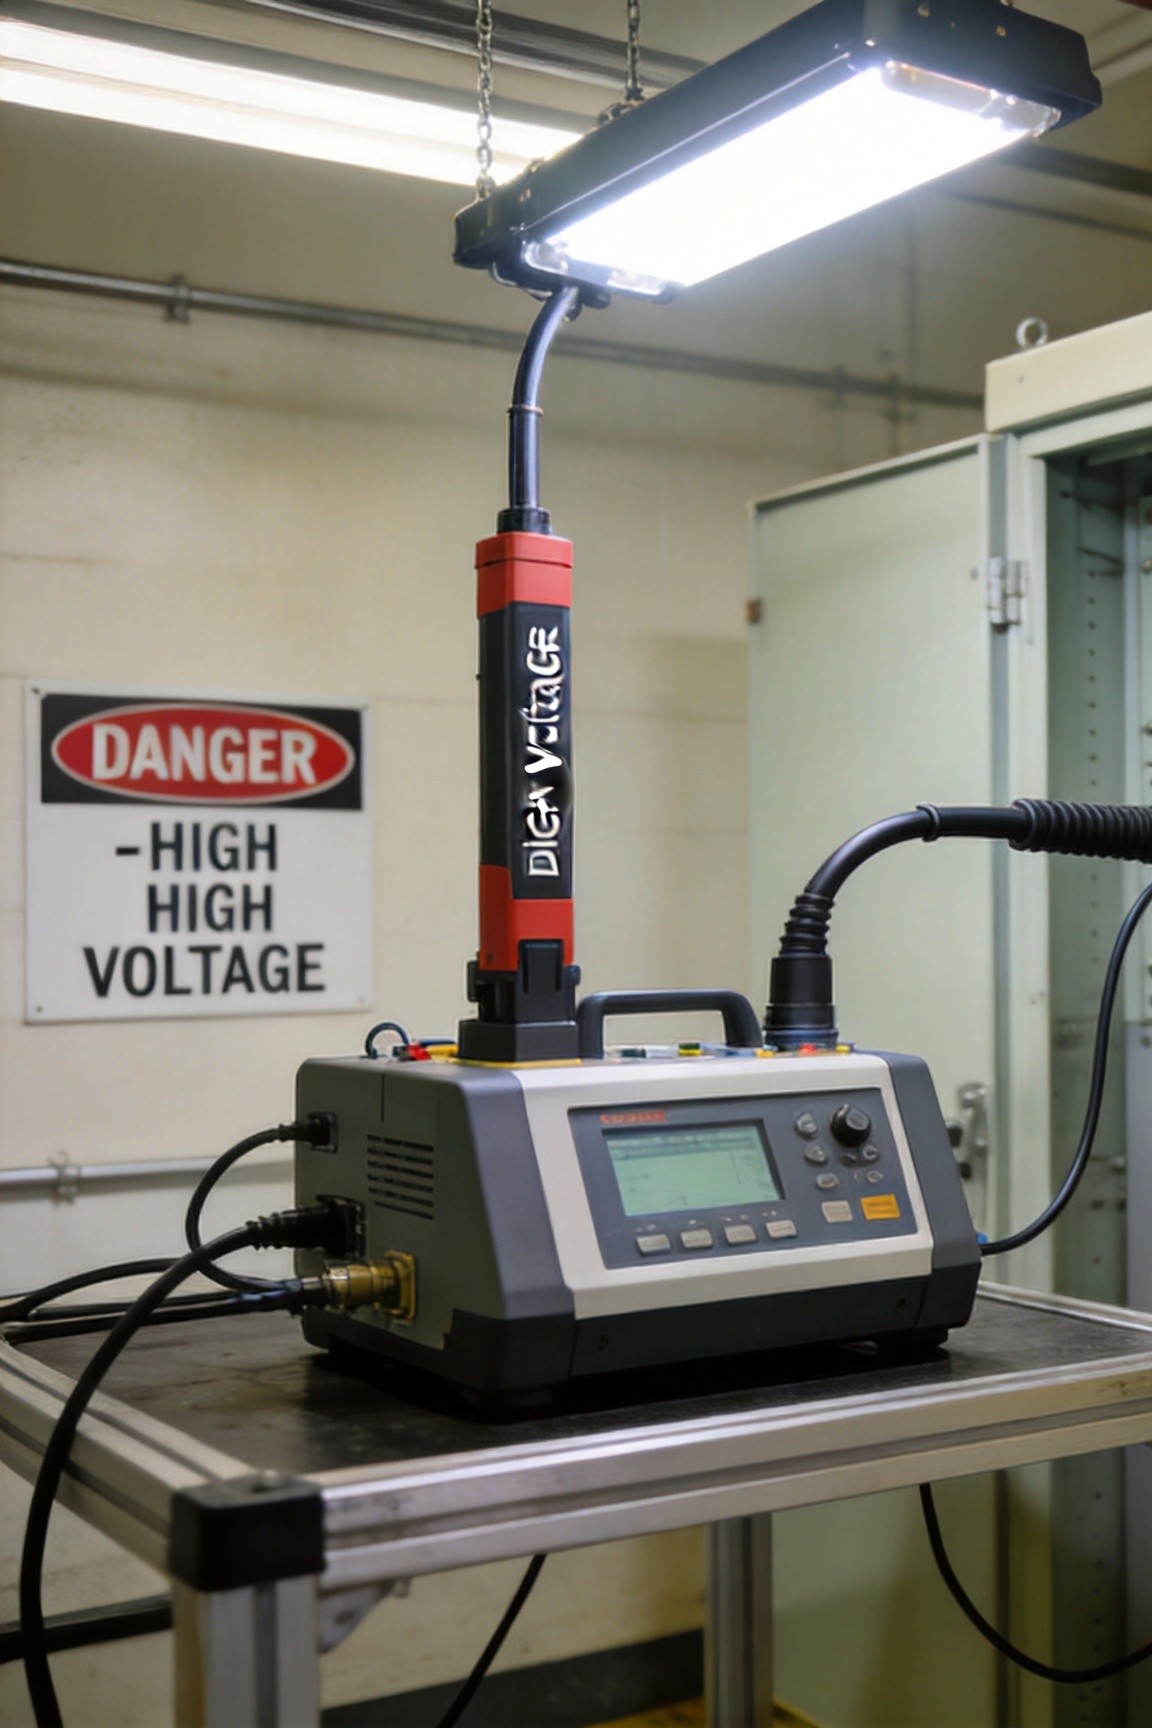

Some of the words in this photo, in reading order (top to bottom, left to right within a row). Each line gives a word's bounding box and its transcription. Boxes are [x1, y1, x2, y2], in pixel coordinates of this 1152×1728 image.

[91, 723, 318, 785] DANGER
[147, 883, 273, 934] HIGH
[82, 943, 326, 998] VOLTAGE
